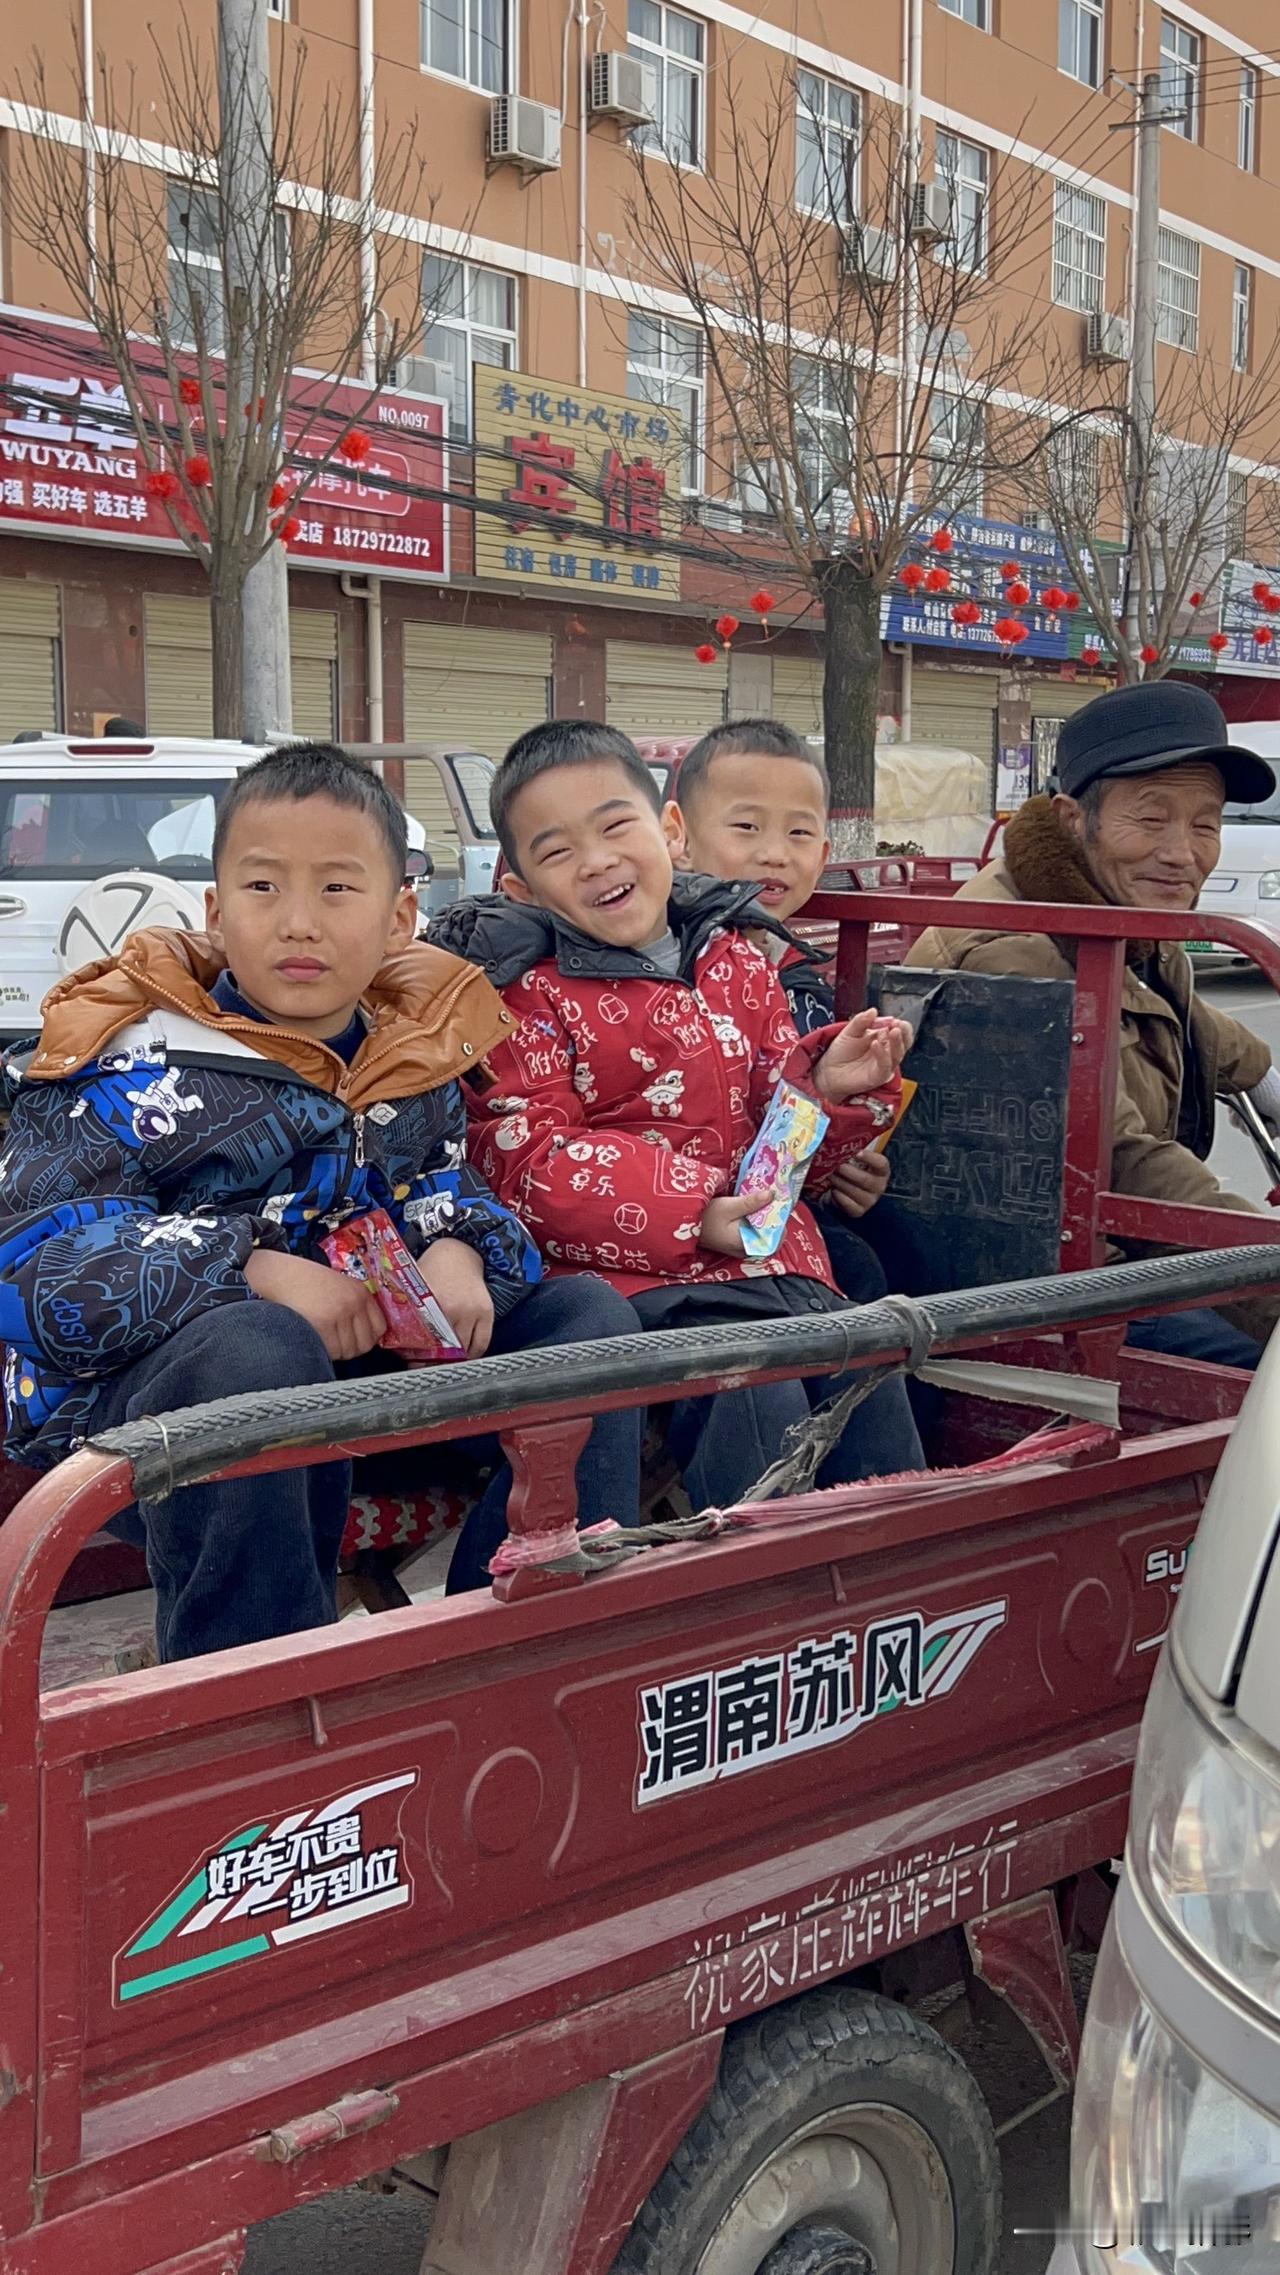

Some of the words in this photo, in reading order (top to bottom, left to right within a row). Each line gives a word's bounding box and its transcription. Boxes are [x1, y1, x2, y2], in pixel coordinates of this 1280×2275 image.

[0, 438, 138, 479] WUYANG
[0, 478, 24, 506] 强
[32, 482, 88, 513] 买好车
[94, 491, 148, 522] 选五羊
[333, 527, 431, 557] 18729722872
[642, 1615, 924, 1791] 渭南苏风
[207, 1813, 361, 1900] 好车不贵
[249, 1848, 399, 1920] 一步到位
